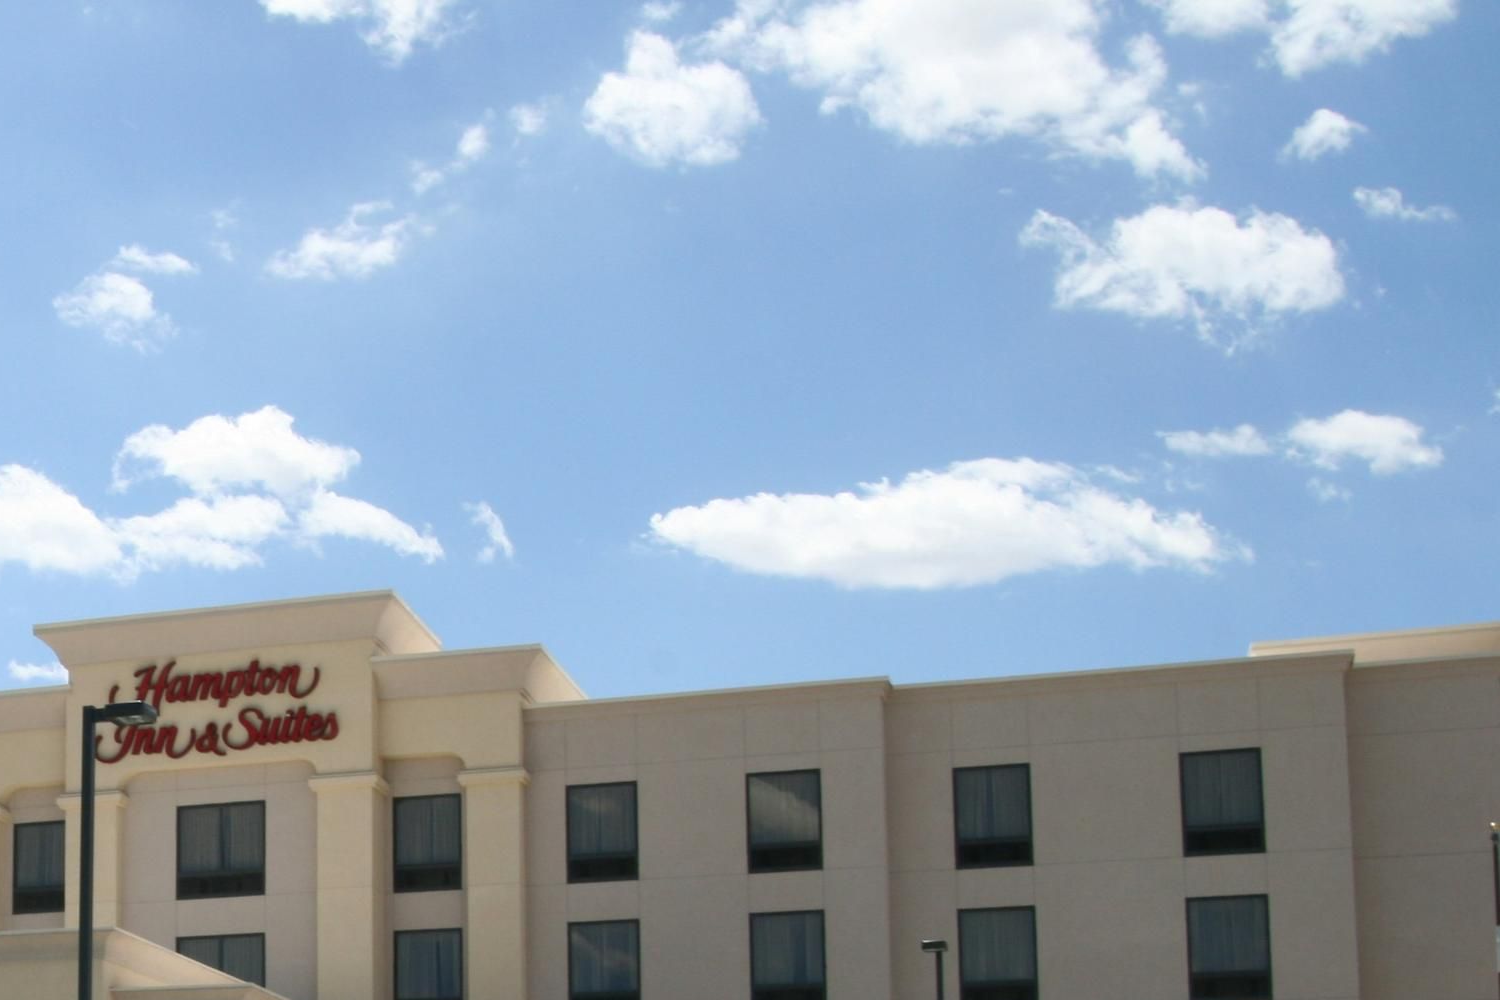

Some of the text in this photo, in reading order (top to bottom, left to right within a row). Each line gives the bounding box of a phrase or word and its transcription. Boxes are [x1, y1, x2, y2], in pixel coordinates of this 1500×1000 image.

[108, 658, 320, 715] Hampton
[94, 704, 339, 763] Inn & Suites
